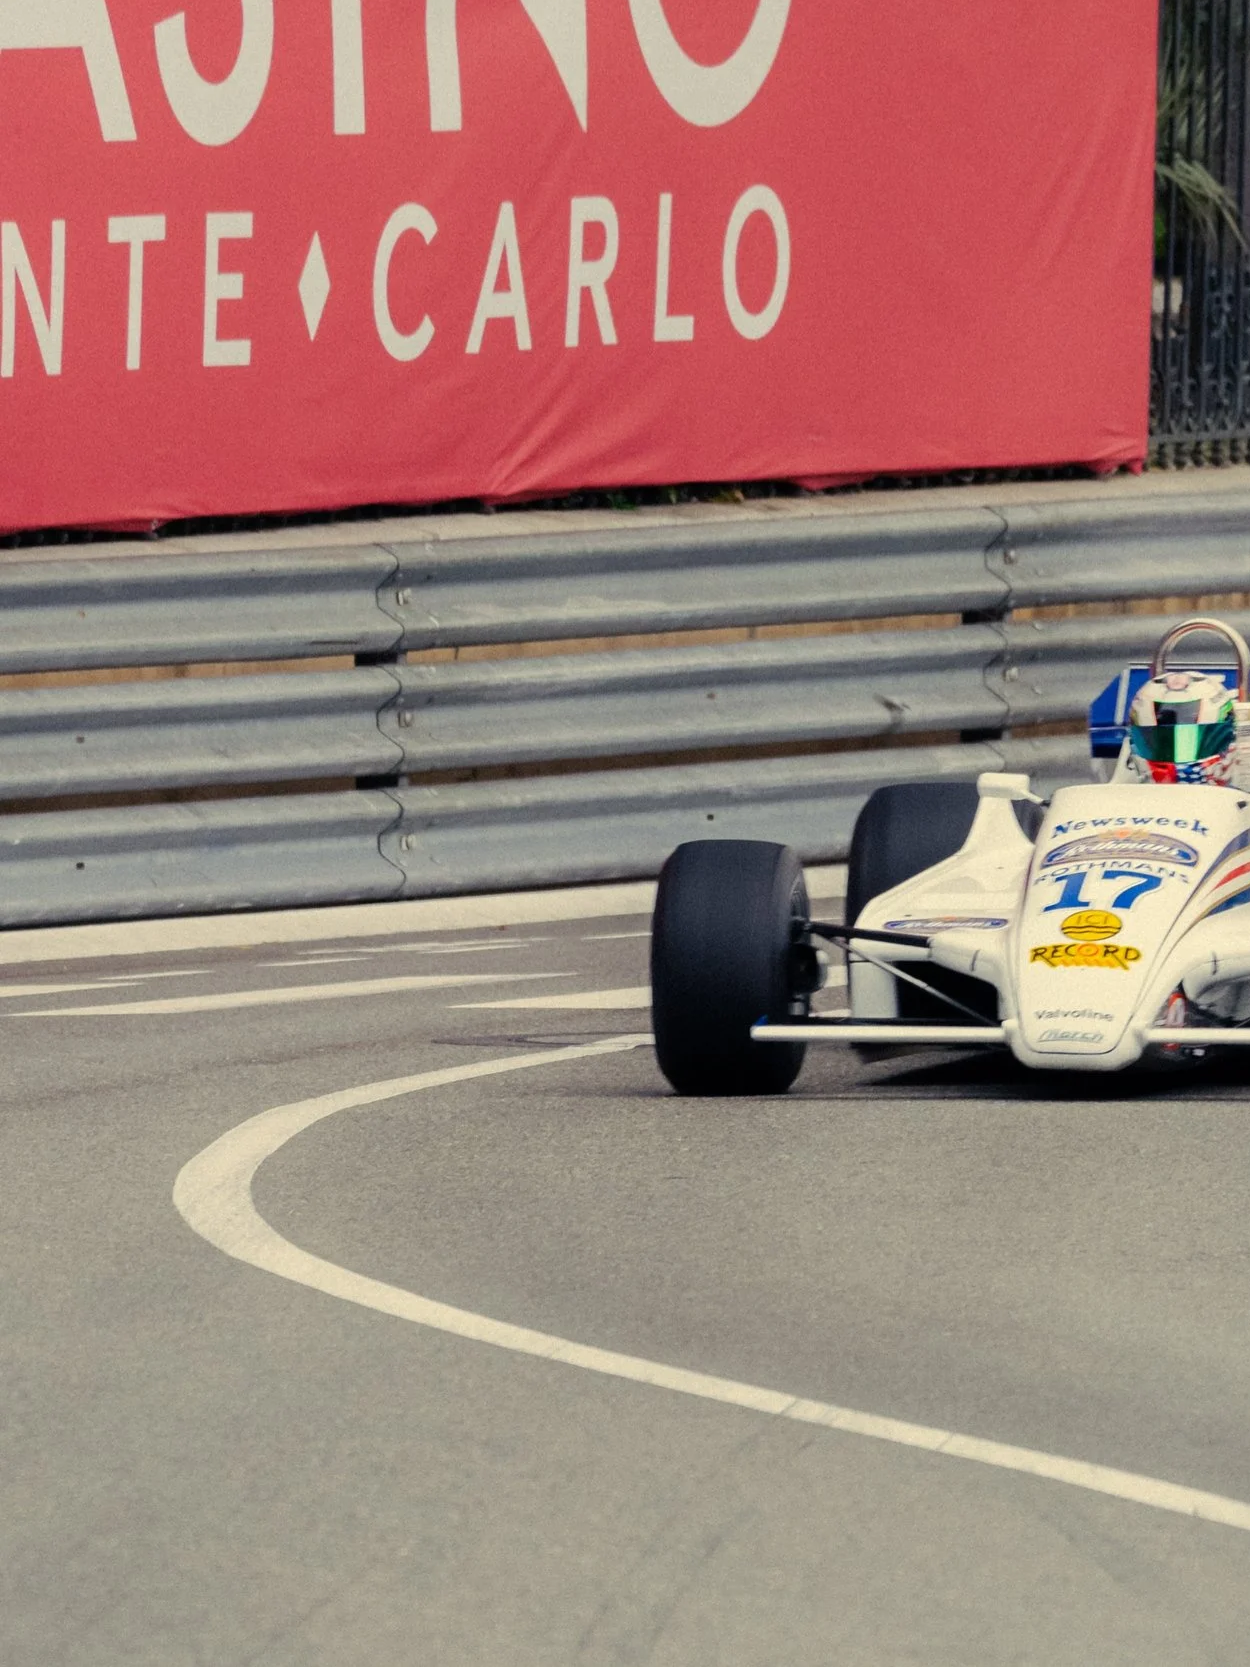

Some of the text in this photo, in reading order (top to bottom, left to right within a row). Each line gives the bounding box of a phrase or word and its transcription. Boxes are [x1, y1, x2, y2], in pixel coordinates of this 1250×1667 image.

[0, 184, 792, 378] NTE CARLO
[1050, 817, 1210, 840] Newsweek
[1042, 869, 1165, 913] 17
[1075, 914, 1109, 926] ICI
[1030, 942, 1142, 971] RECORD
[1034, 1008, 1114, 1022] Valvoline
